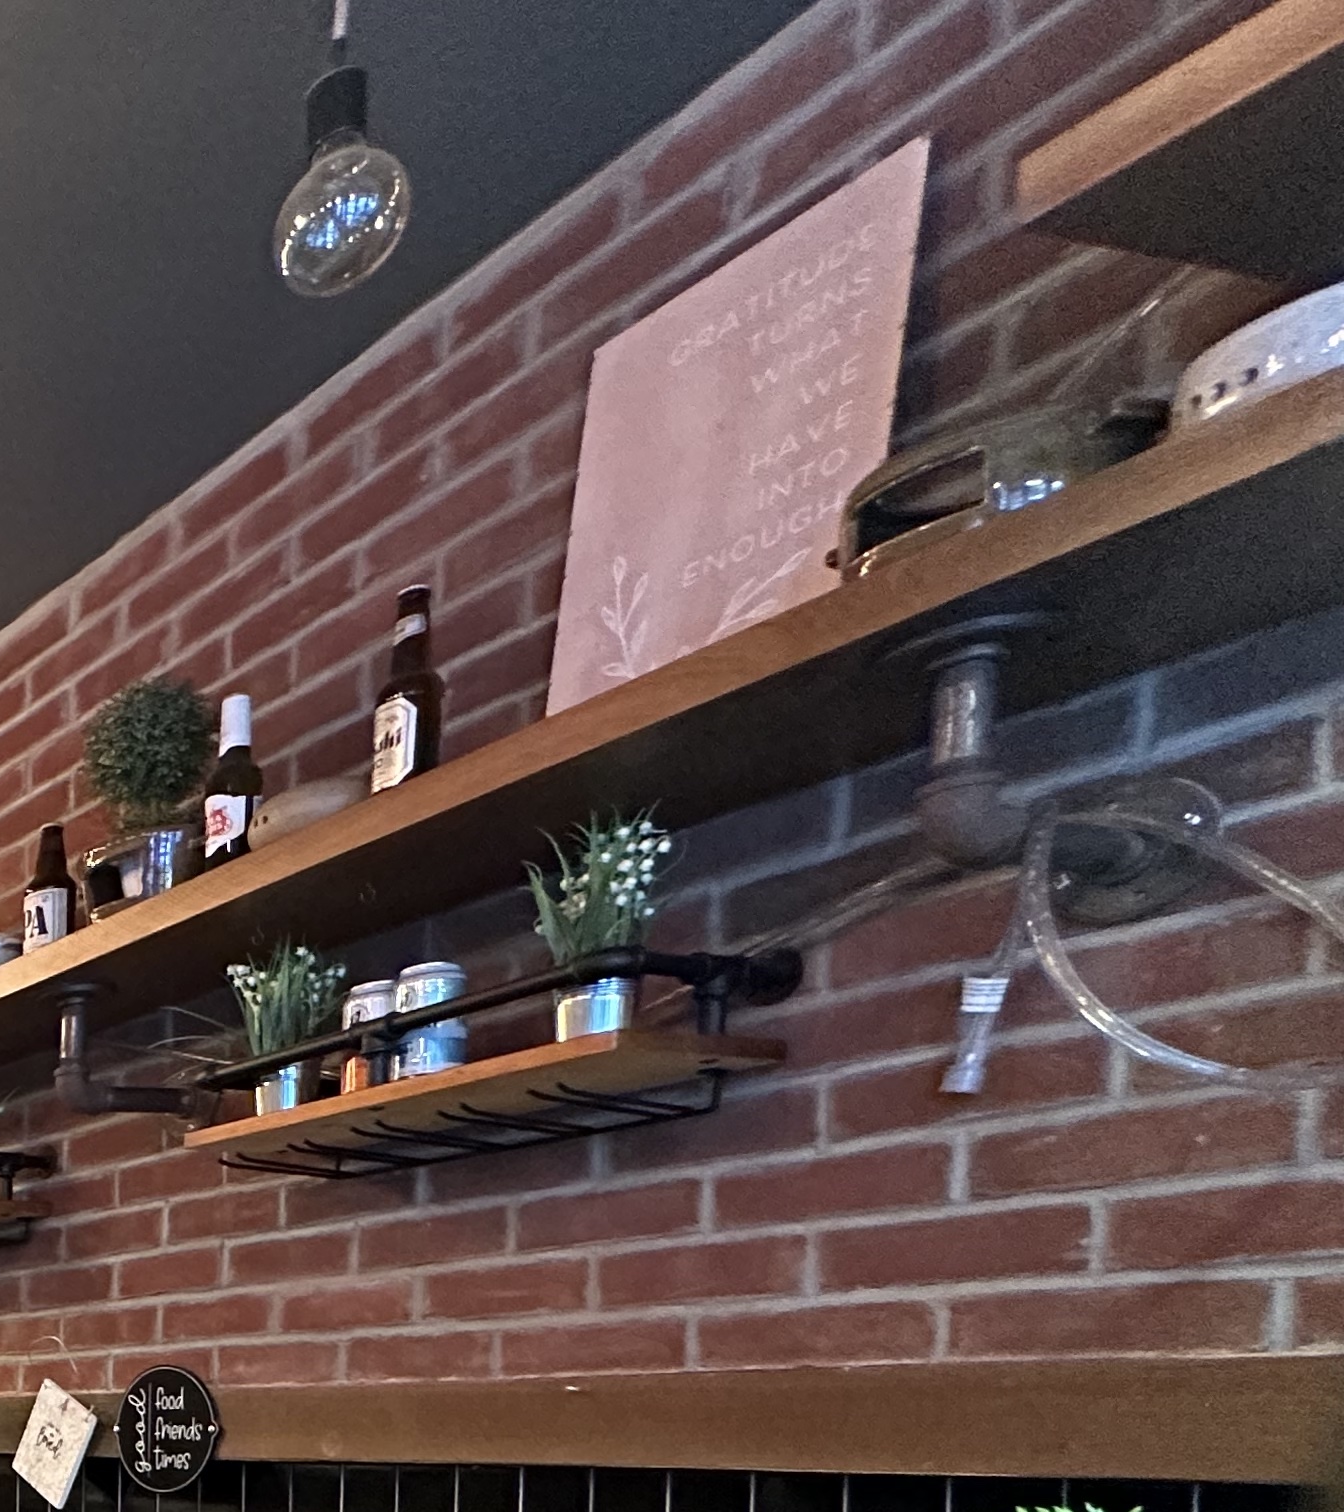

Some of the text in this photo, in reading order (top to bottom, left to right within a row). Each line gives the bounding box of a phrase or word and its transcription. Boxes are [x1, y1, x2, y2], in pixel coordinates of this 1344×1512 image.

[668, 223, 876, 368] GRATITUDE
[748, 267, 872, 356] TURNS
[750, 309, 869, 394] WHAT
[799, 354, 860, 405] WE
[748, 400, 854, 477] HAVE
[758, 447, 850, 512] INTO
[680, 491, 845, 588] ENOUGH
[127, 1388, 152, 1473] good
[154, 1386, 185, 1411] food
[154, 1416, 203, 1442] friends
[153, 1447, 192, 1471] times
